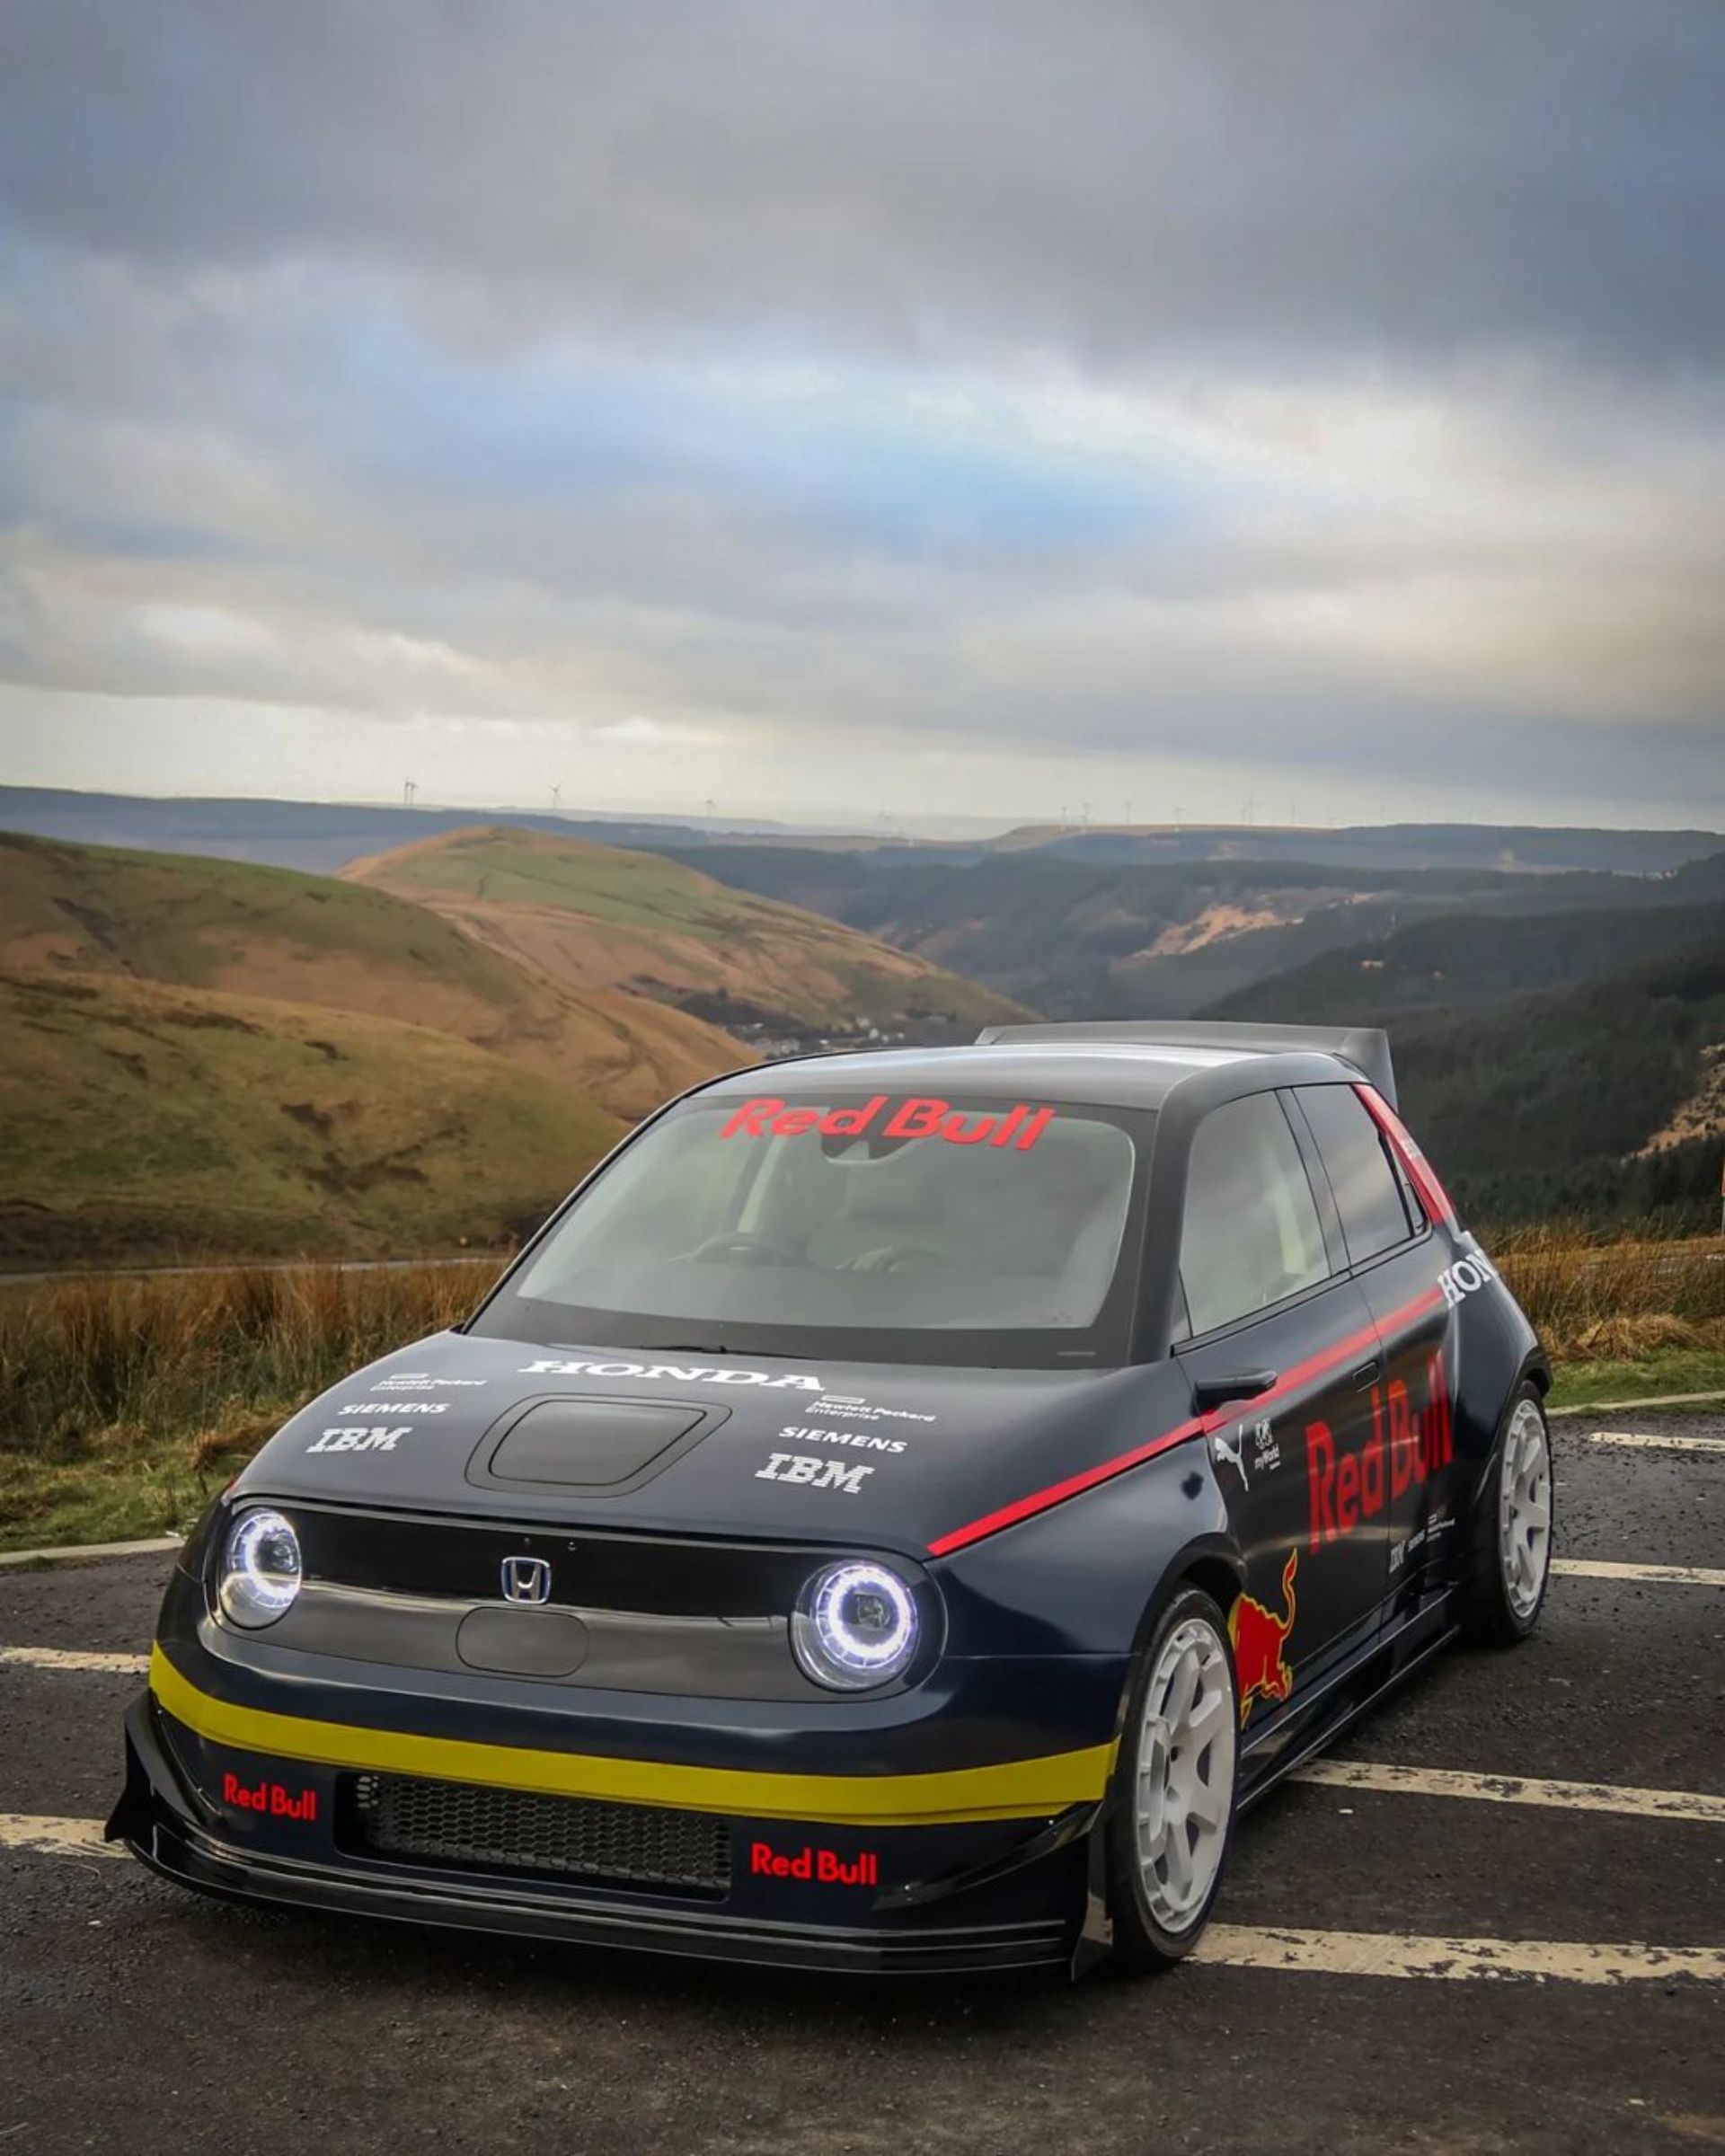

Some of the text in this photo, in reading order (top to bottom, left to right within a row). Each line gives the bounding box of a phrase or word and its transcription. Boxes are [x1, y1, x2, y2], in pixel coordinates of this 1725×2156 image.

[721, 1095, 1056, 1151] Red Bull
[518, 1359, 826, 1392] HONDA
[338, 1402, 451, 1416] SIEMENS
[305, 1427, 413, 1454] IBM
[778, 1426, 908, 1454] SIEMENS
[1305, 1349, 1454, 1555] Red Bull
[754, 1452, 876, 1495] IBM
[223, 1772, 317, 1822] Red Bull
[751, 1842, 878, 1886] Red Bull
